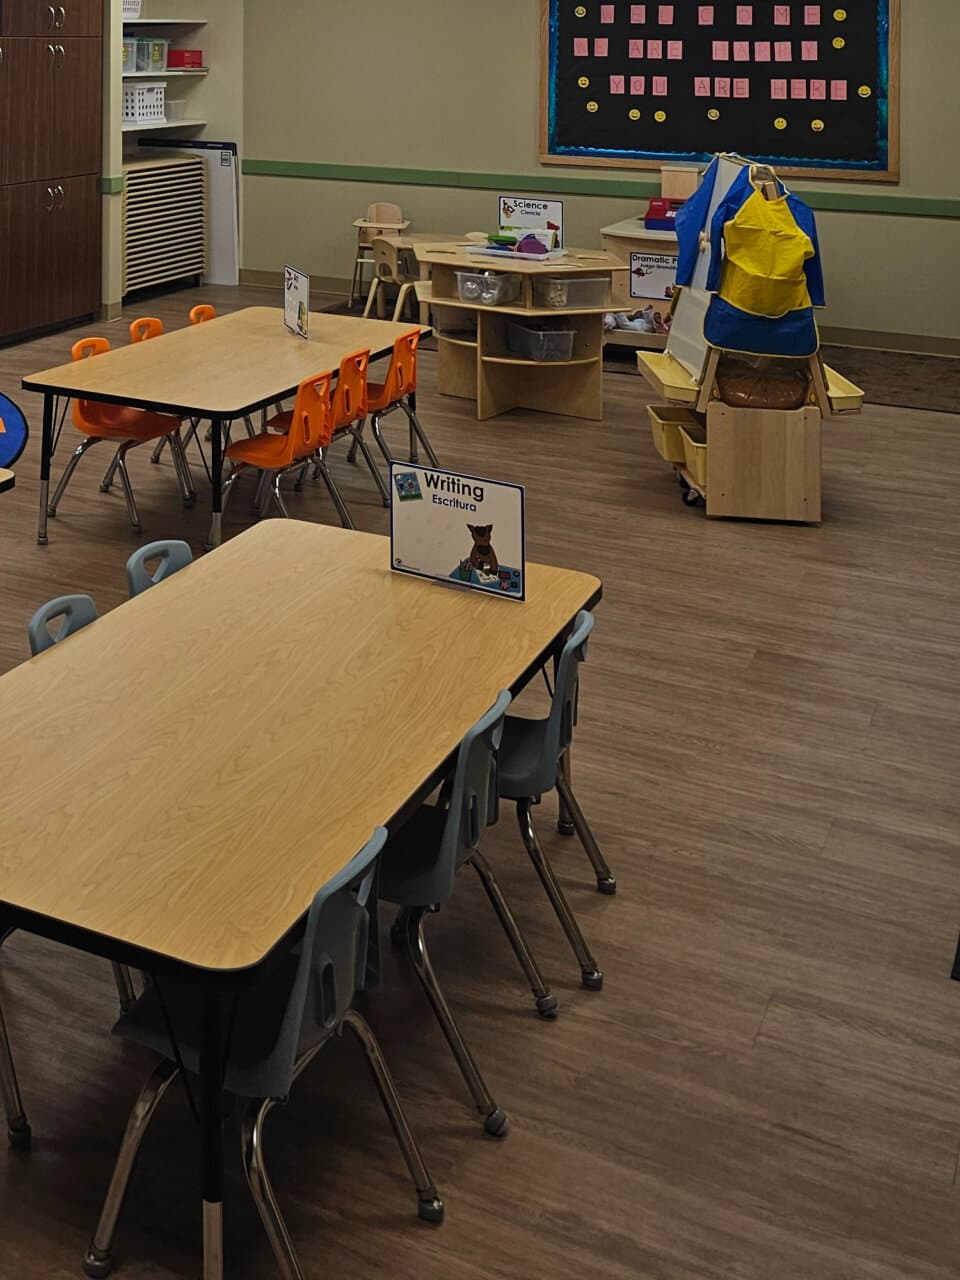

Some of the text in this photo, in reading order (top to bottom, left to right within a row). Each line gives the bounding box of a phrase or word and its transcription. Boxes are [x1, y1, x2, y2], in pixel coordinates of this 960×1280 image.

[610, 75, 667, 95] YOU
[694, 77, 749, 97] ARE
[513, 200, 549, 210] Science
[632, 254, 670, 264] Dramatic
[424, 471, 484, 503] Writing
[432, 493, 477, 512] Escritura
